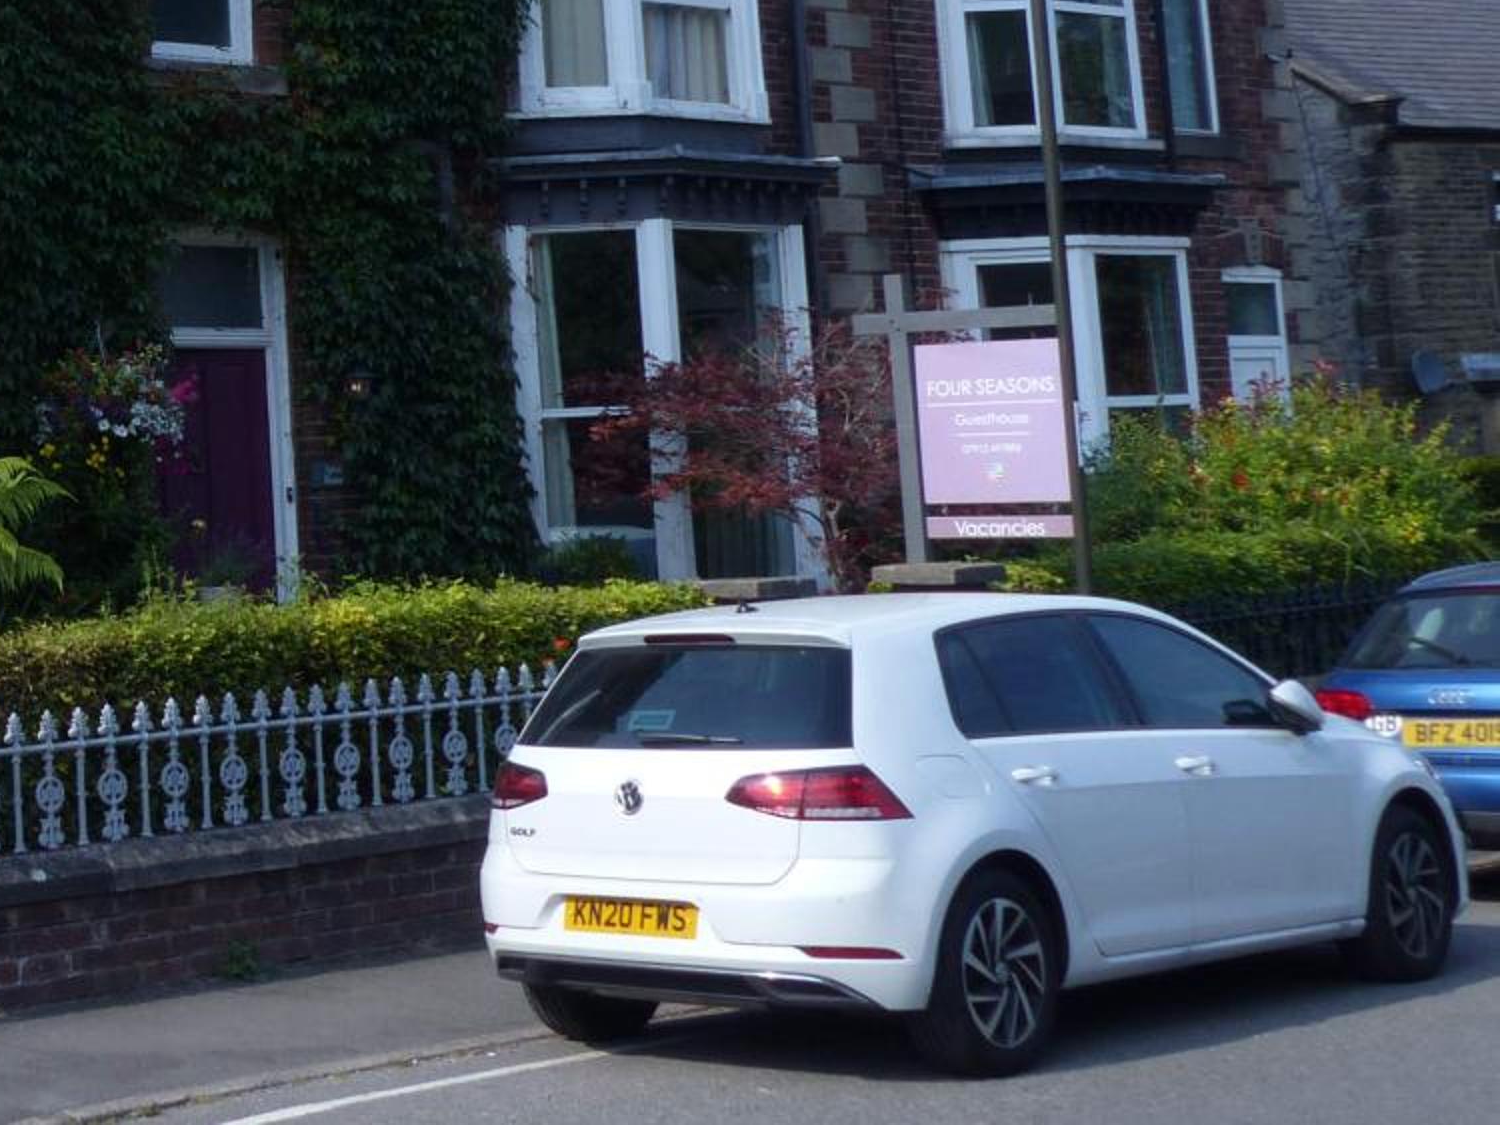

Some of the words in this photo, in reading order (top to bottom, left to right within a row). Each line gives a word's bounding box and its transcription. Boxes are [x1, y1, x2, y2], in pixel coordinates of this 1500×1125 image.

[927, 378, 971, 396] FOUR
[974, 376, 1055, 395] SEASONS
[955, 521, 1045, 537] Vacancies
[1416, 723, 1455, 743] BFZ
[510, 826, 536, 837] GOLF
[573, 899, 633, 928] KN20
[639, 903, 686, 931] FWS
